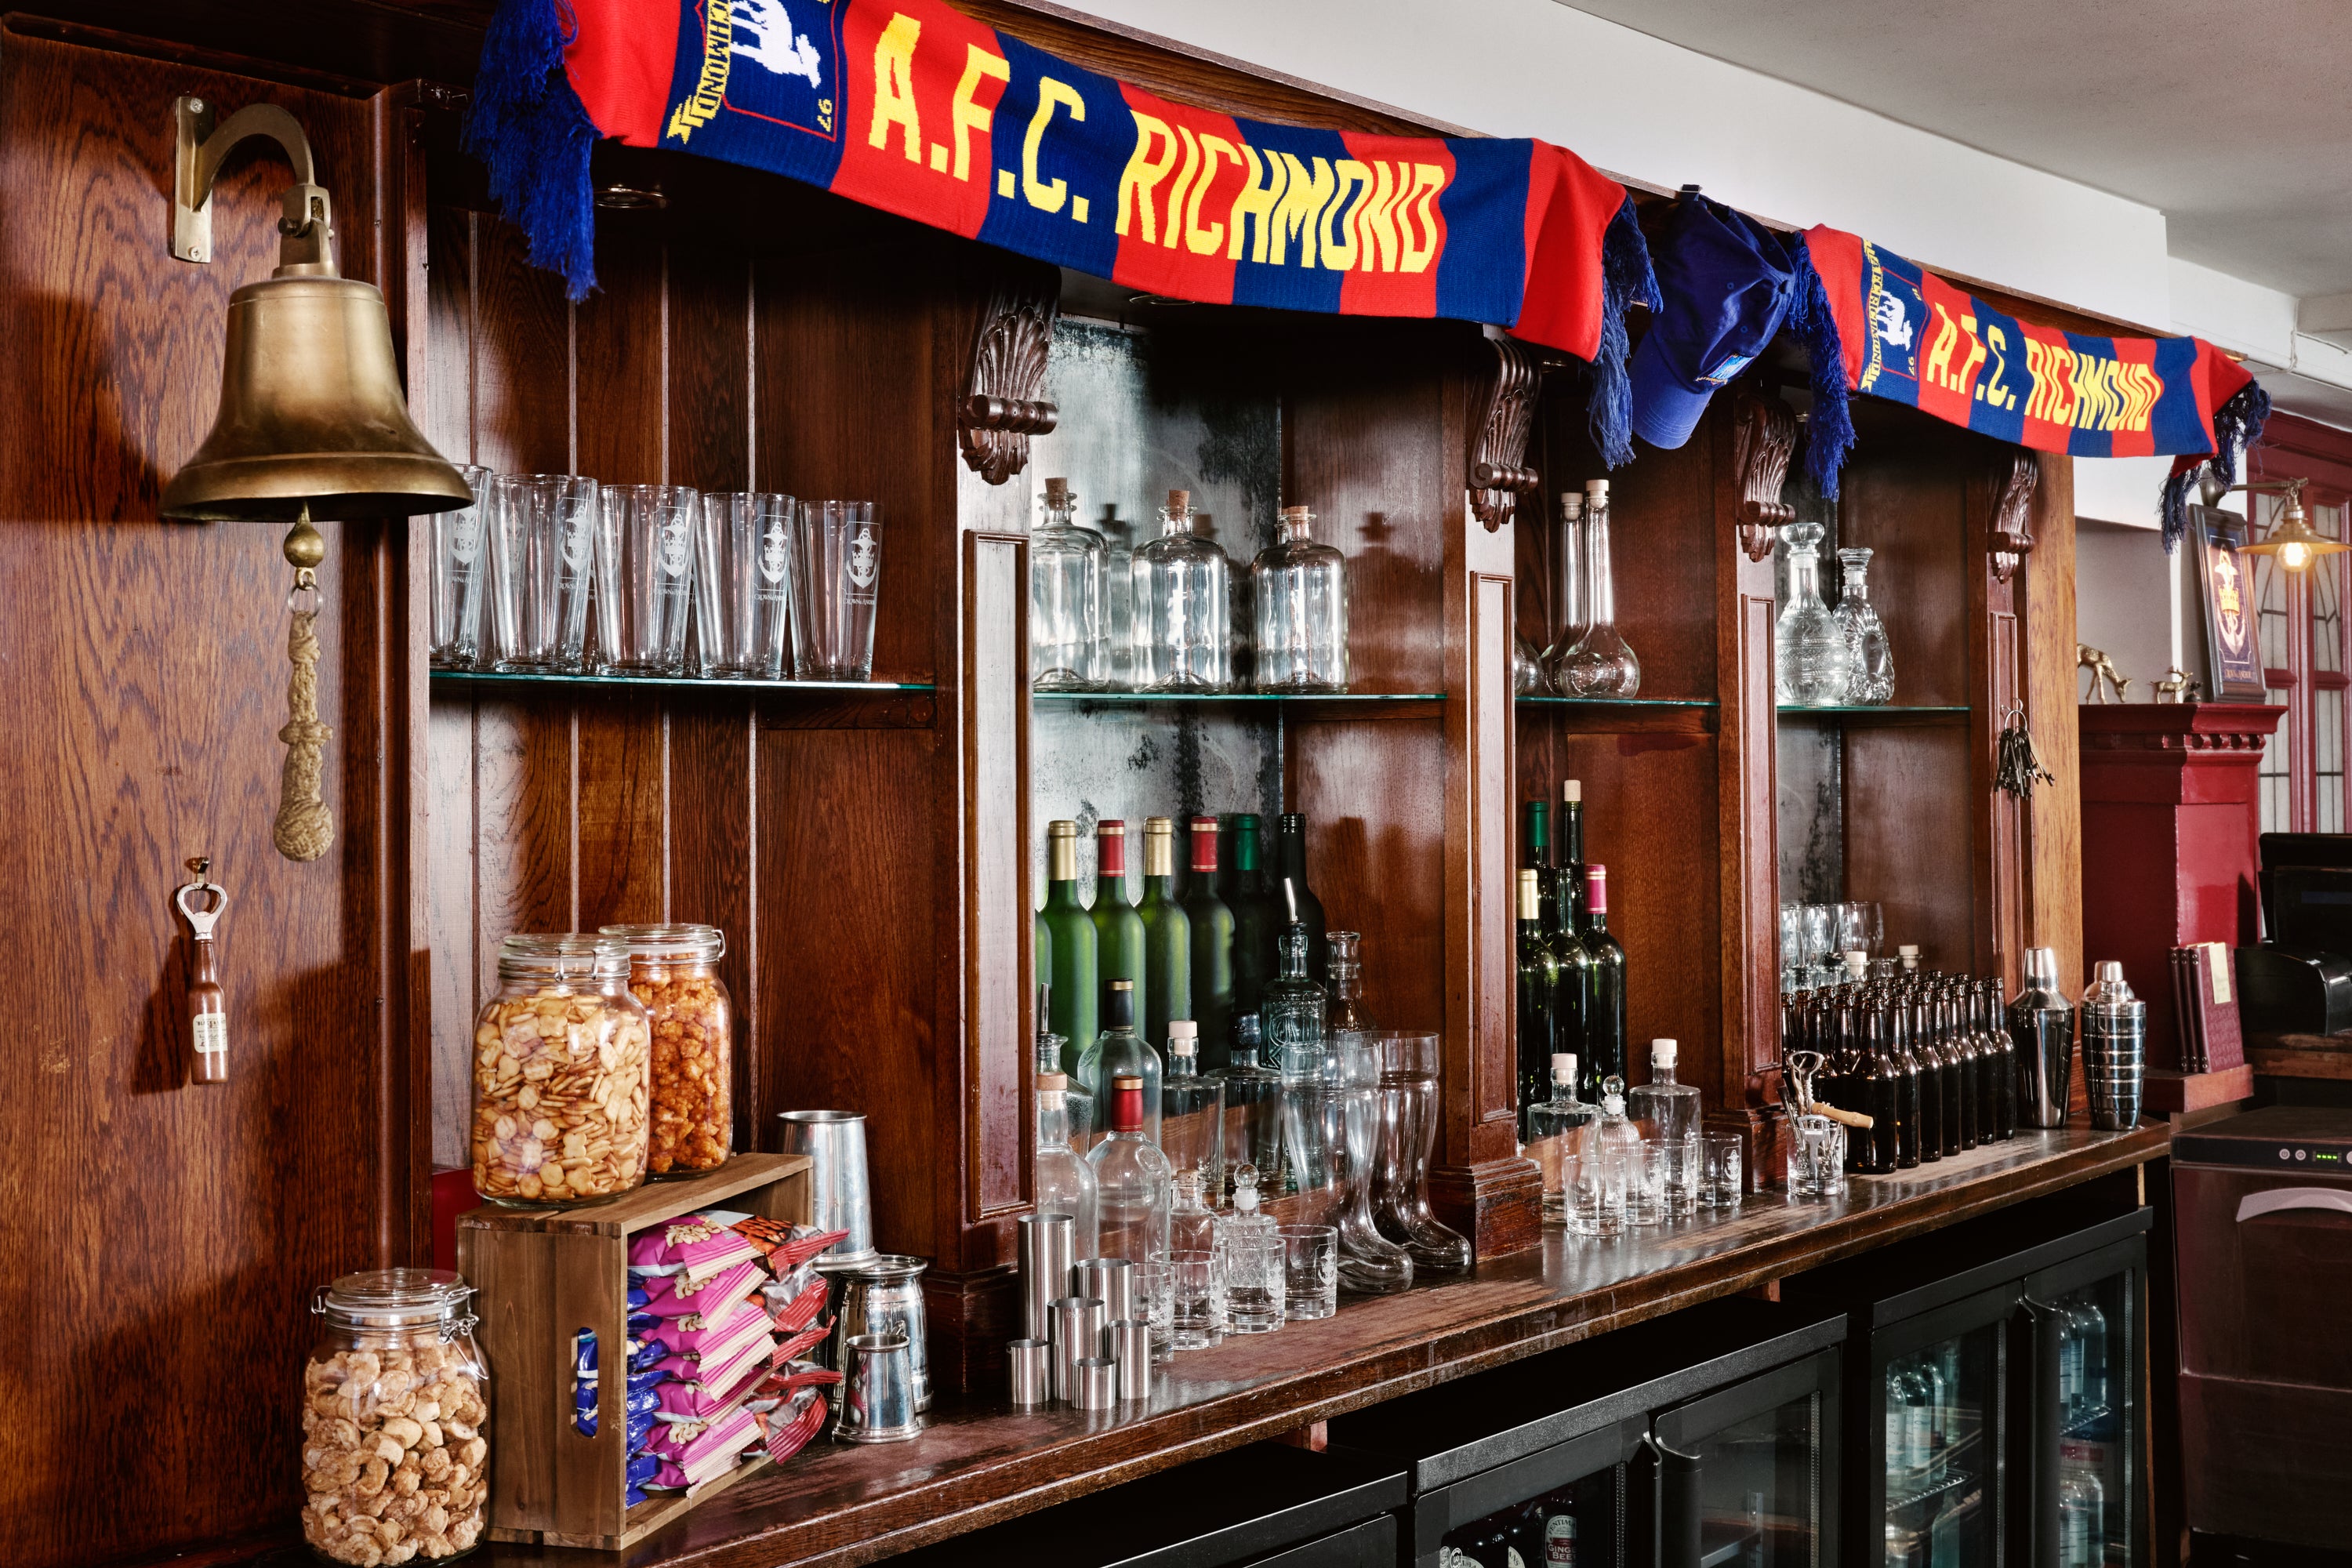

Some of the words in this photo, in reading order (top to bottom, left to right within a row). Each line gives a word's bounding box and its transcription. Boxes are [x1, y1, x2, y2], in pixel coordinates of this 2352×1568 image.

[697, 0, 729, 111] CHMOND
[868, 12, 1090, 223] A.F.C.
[1115, 109, 1446, 273] RICHMOND
[2024, 336, 2164, 431] RICHMOND
[1552, 1552, 1573, 1560] BEE
